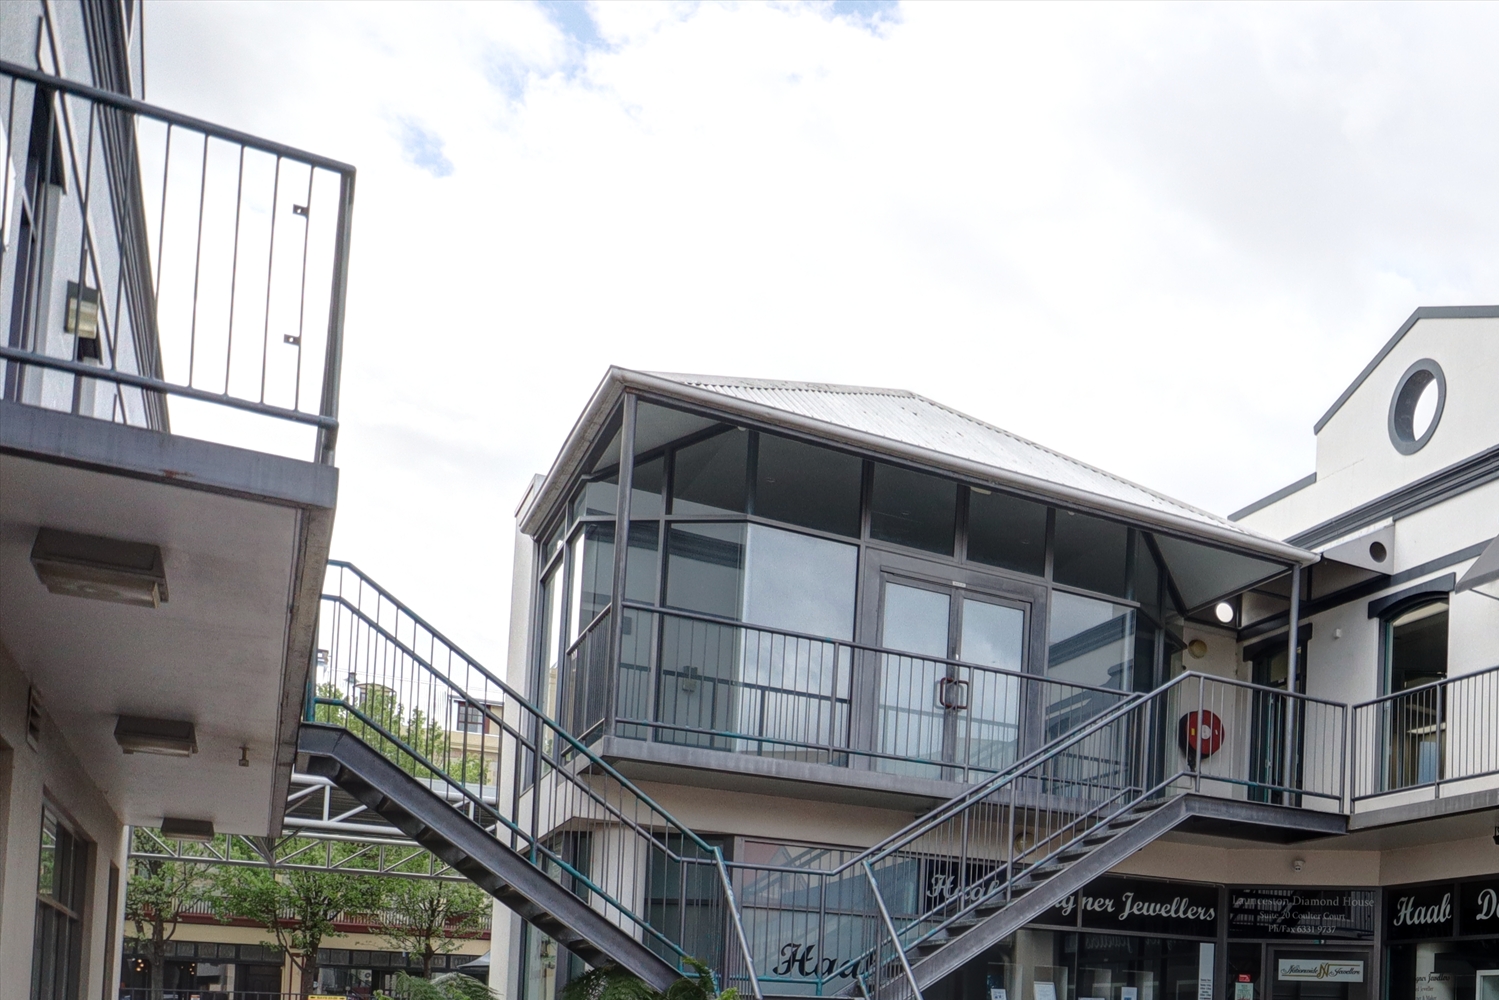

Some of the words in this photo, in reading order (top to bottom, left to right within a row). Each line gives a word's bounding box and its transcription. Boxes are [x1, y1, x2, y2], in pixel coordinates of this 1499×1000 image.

[1118, 892, 1216, 921] Jewellers
[1232, 894, 1290, 906] Launceston
[1293, 895, 1340, 907] Diamond
[1342, 896, 1375, 908] House
[1393, 892, 1453, 927] Haab
[1259, 911, 1279, 920] Suite
[1281, 911, 1291, 919] 20
[1292, 911, 1322, 920] Coulter
[1322, 912, 1346, 921] Court
[1268, 924, 1295, 934] Ph/Fax
[1296, 925, 1315, 934] 6331
[1316, 925, 1337, 934] 9737
[1329, 967, 1361, 977] Jewellers
